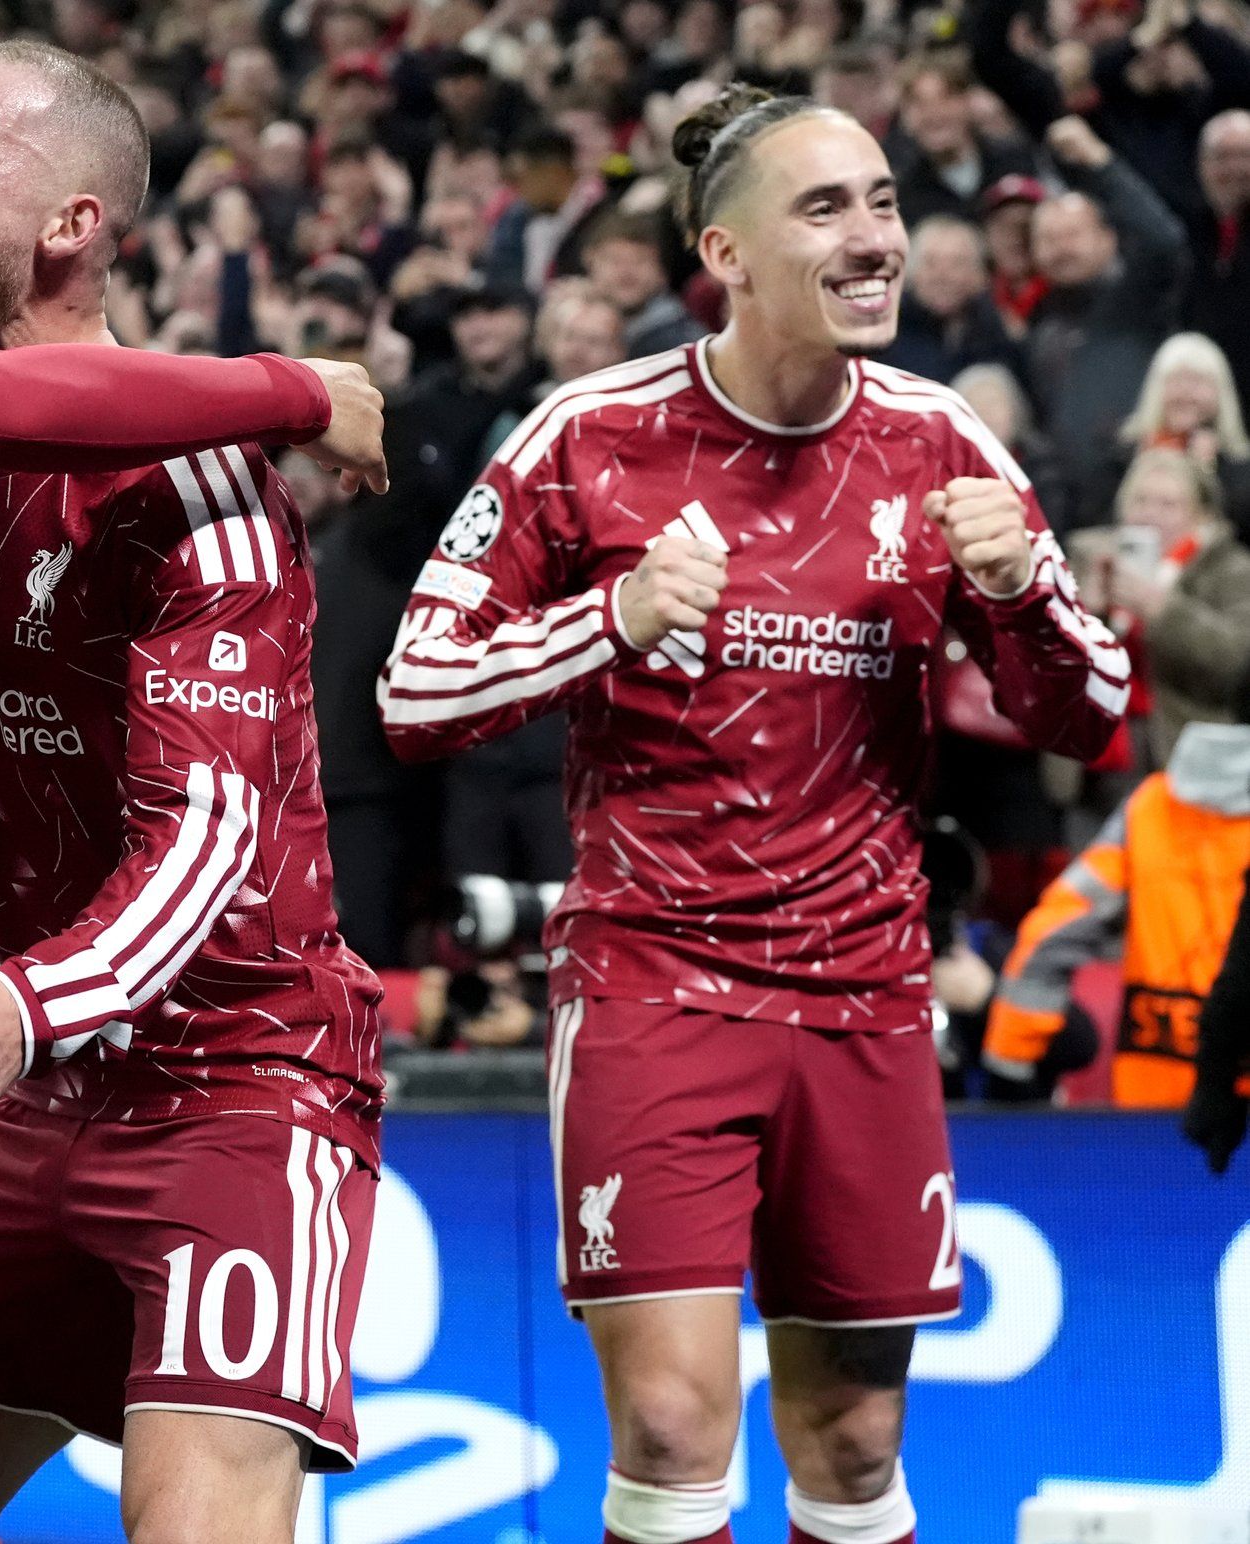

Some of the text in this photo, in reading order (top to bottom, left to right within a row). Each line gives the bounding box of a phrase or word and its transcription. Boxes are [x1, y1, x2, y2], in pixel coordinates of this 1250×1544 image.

[722, 605, 893, 648] standard
[721, 637, 895, 680] chartered
[145, 669, 278, 722] Expedi
[920, 1169, 961, 1291] 2
[154, 1242, 279, 1381] 10
